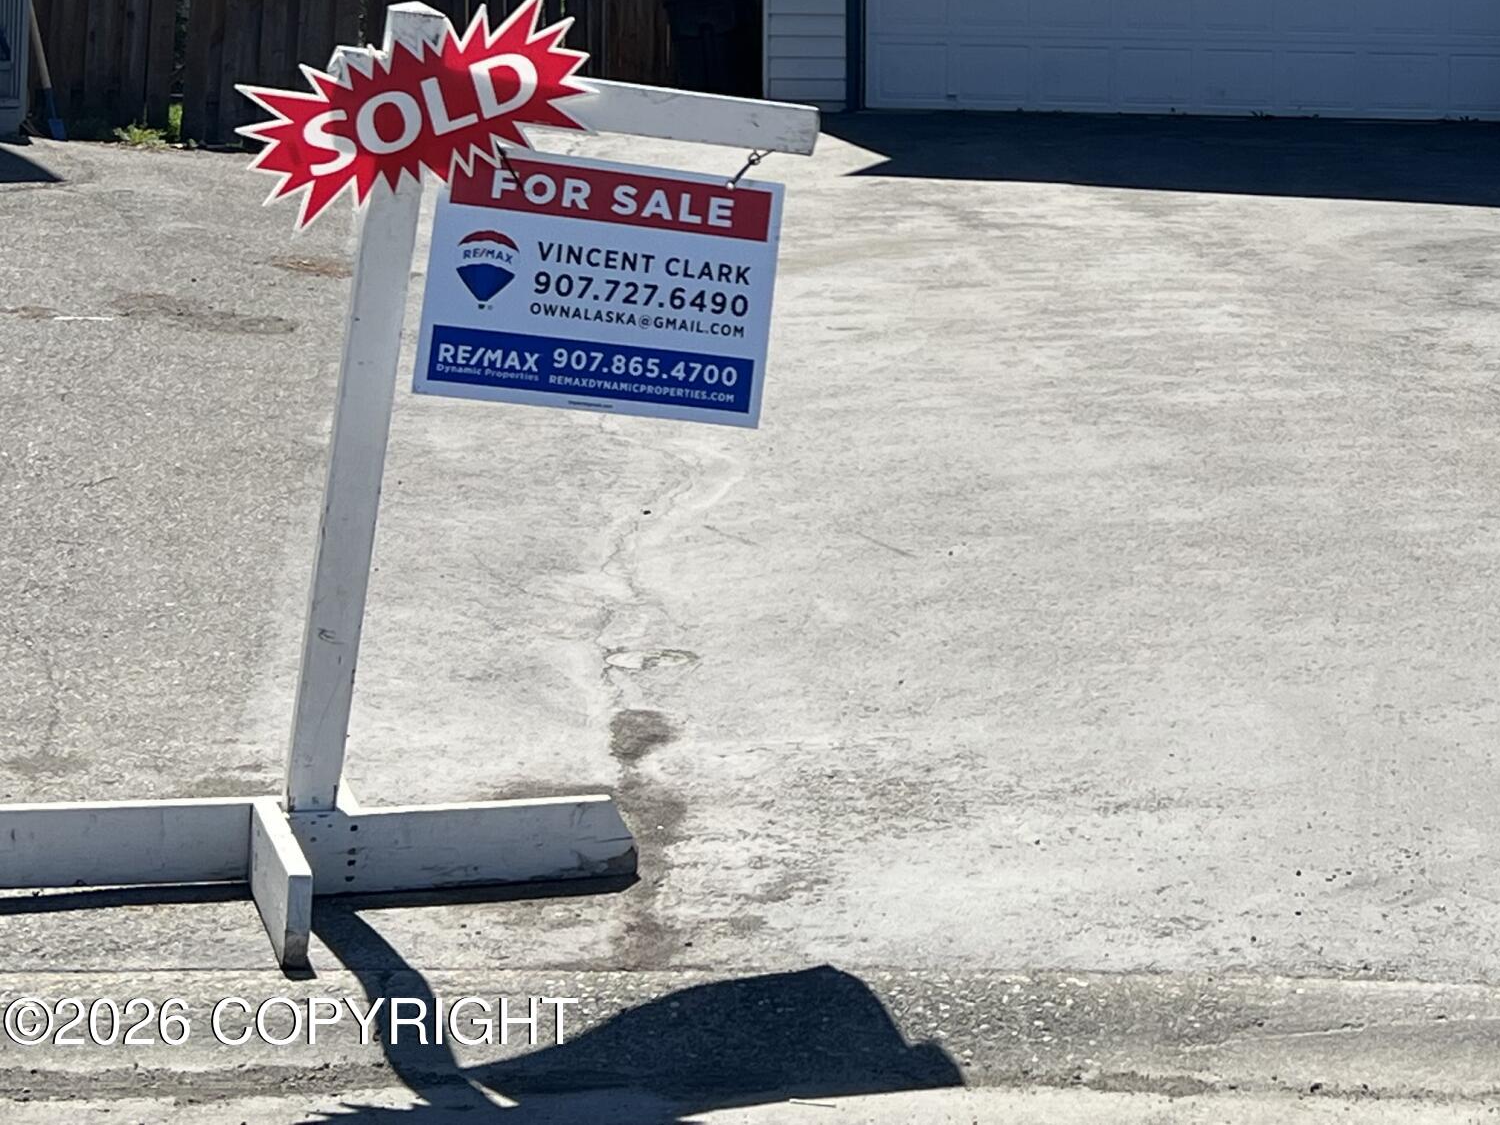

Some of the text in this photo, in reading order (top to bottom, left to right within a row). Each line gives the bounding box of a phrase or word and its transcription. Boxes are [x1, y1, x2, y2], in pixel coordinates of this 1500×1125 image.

[302, 53, 539, 176] SOLD
[490, 168, 735, 228] FOR SALE
[462, 247, 514, 266] RE/MAX
[537, 241, 752, 286] VINCENT CLARK
[533, 271, 750, 318] 907.727.6490
[529, 302, 746, 339] OWNALASKA@GMAIL.COM
[436, 363, 540, 382] Dynamic Properties
[437, 342, 540, 373] RE/MAX
[552, 347, 739, 387] 907.865.4700
[549, 374, 736, 404] REMAXDYNAMICPROPERTIES.COM
